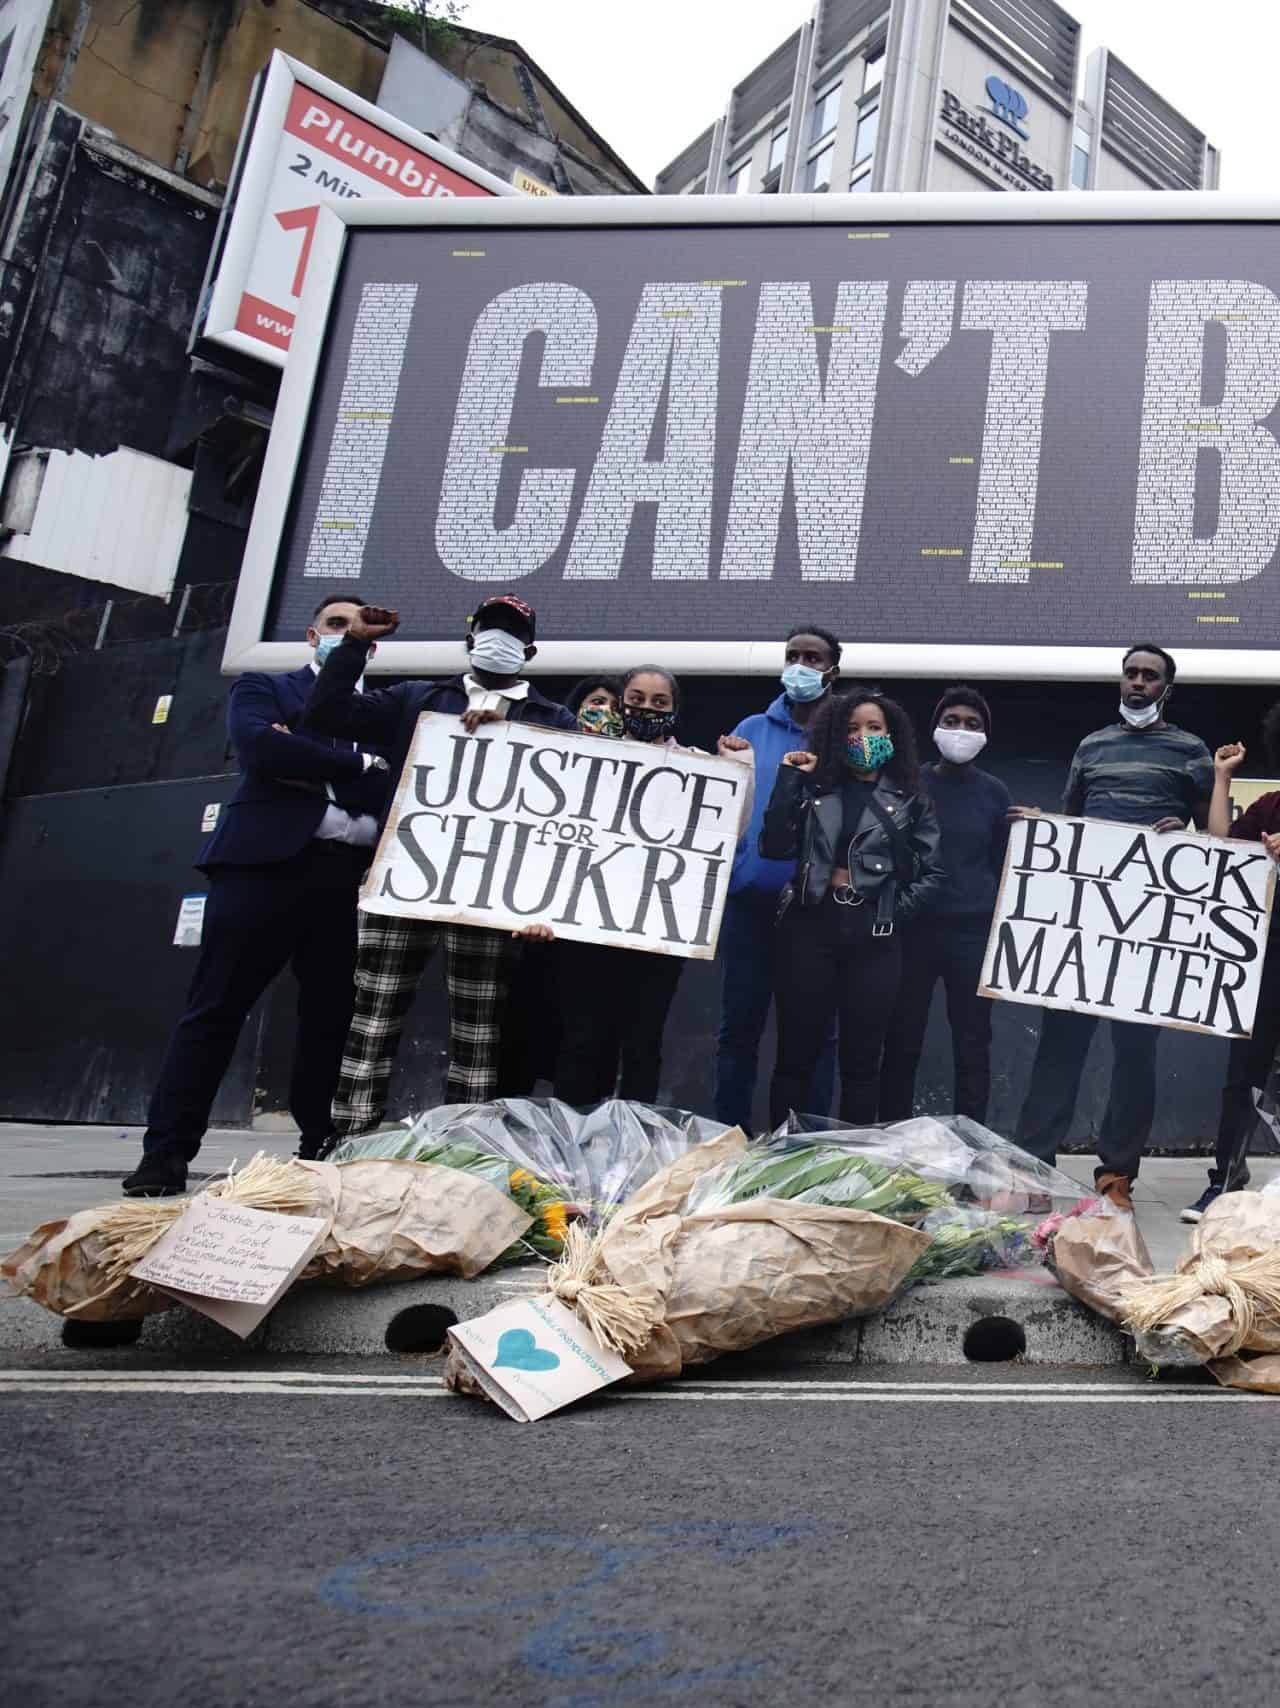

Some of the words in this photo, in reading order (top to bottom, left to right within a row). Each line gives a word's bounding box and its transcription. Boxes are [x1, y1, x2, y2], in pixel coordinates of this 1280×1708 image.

[289, 154, 313, 178] 2
[303, 282, 419, 580] I
[435, 279, 1089, 583] CAN'T
[412, 735, 737, 857] JUSTICE
[380, 810, 727, 946] SHUKRI
[1006, 871, 1260, 963] LIVES
[1012, 817, 1268, 914] BLACK
[985, 922, 1251, 1036] MATTER
